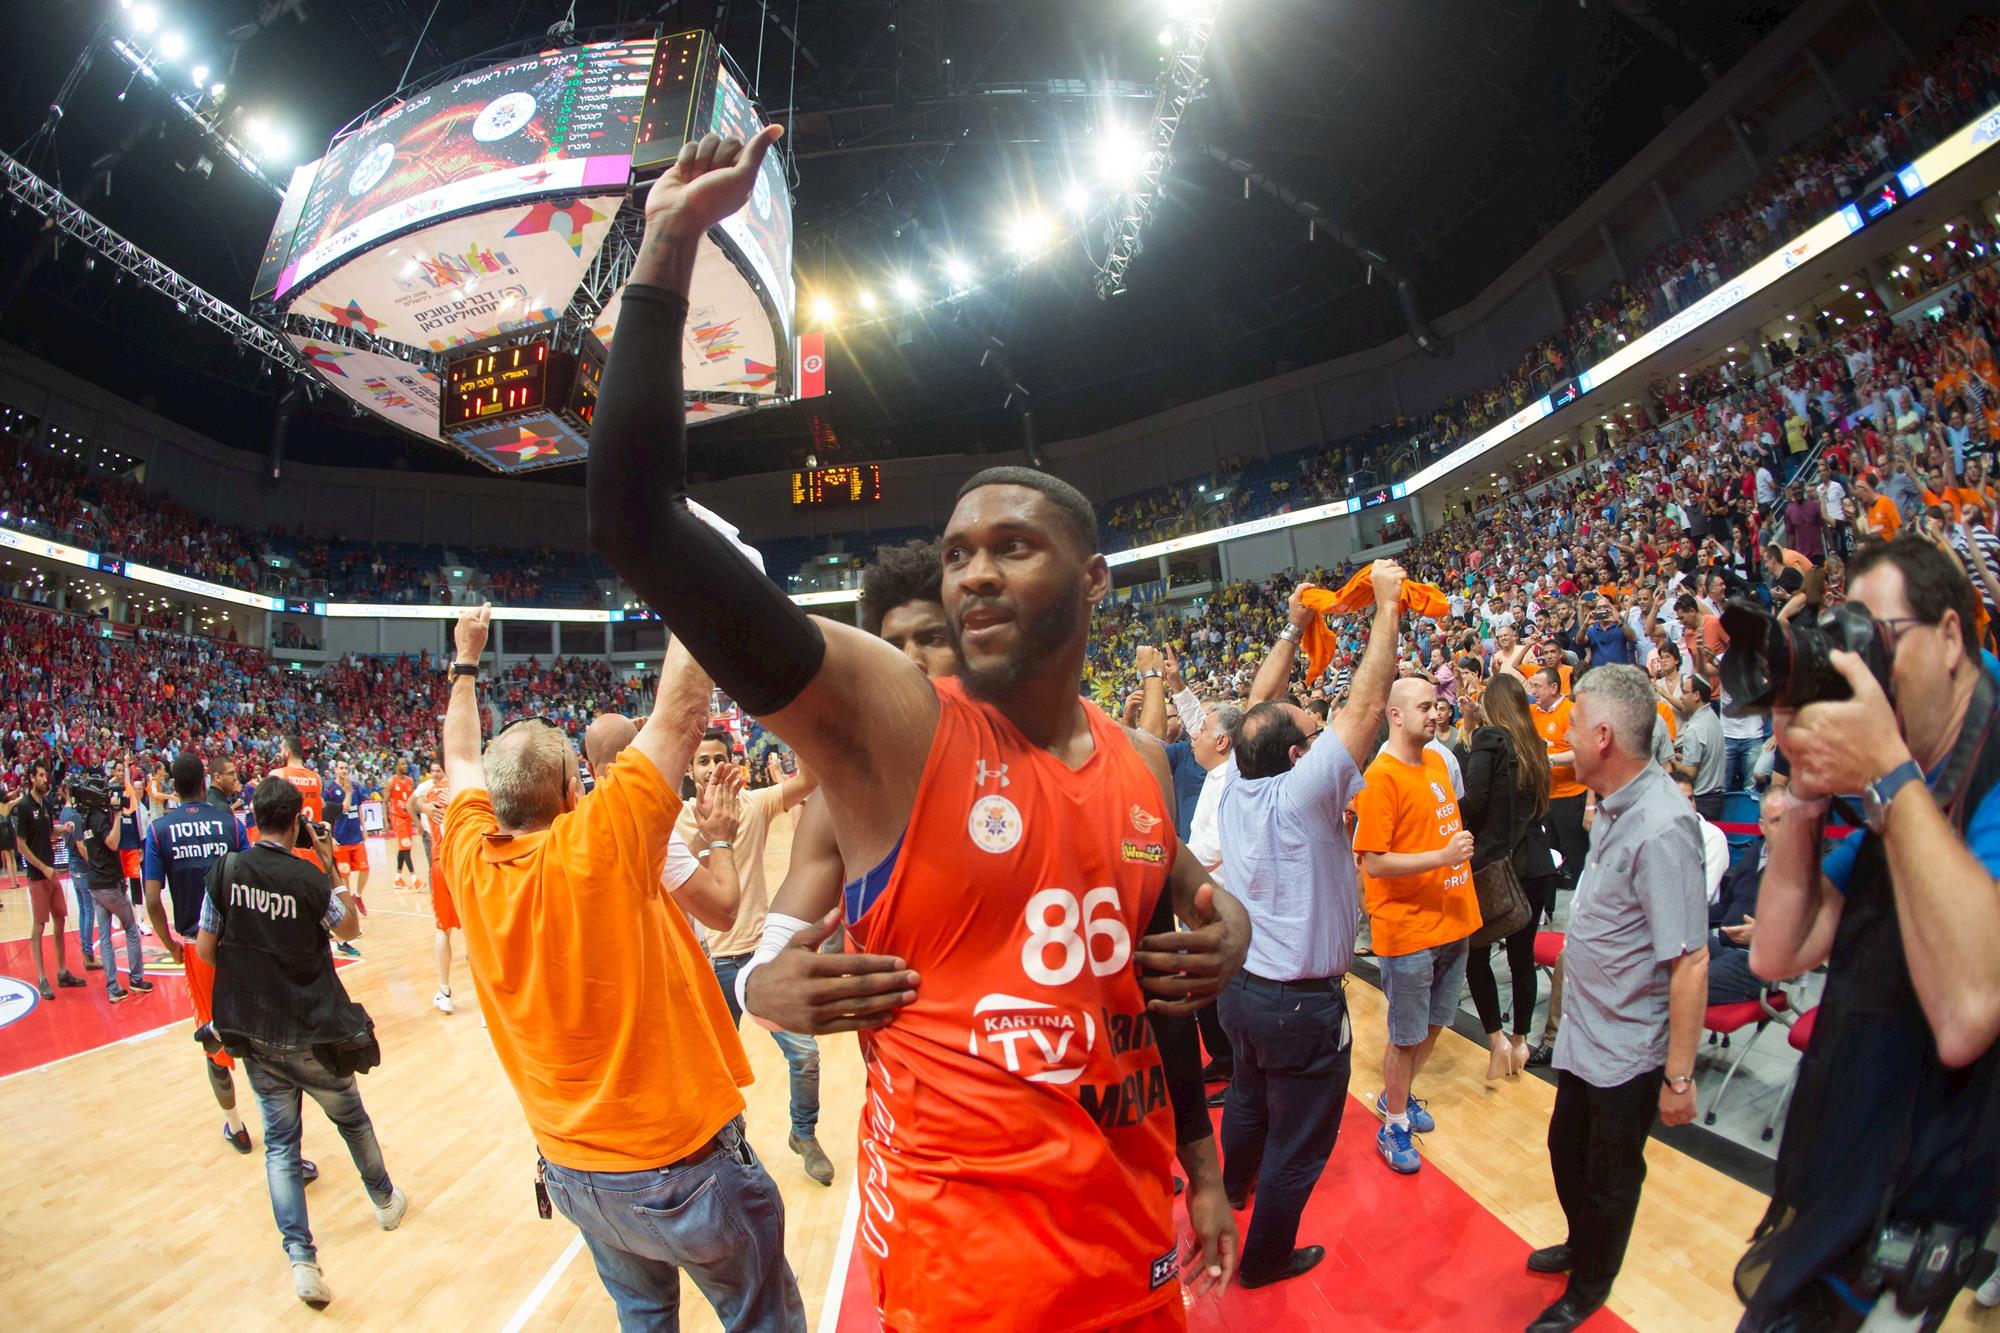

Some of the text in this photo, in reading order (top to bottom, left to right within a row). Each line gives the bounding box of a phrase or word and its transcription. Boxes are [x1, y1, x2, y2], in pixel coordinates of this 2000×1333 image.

[504, 60, 539, 77] מדיה
[544, 54, 578, 67] ראנד
[567, 79, 579, 87] 10
[414, 291, 496, 322] דברים טובים
[420, 319, 444, 333] כאן
[1435, 803, 1455, 819] KEEP
[169, 820, 224, 843] דאוסון
[171, 842, 229, 860] קניון הזהב
[1123, 843, 1161, 862] Winner
[230, 883, 297, 920] תקשורת
[1021, 886, 1132, 986] 86
[984, 1013, 1075, 1032] KARTINA
[987, 1028, 1076, 1072] TV
